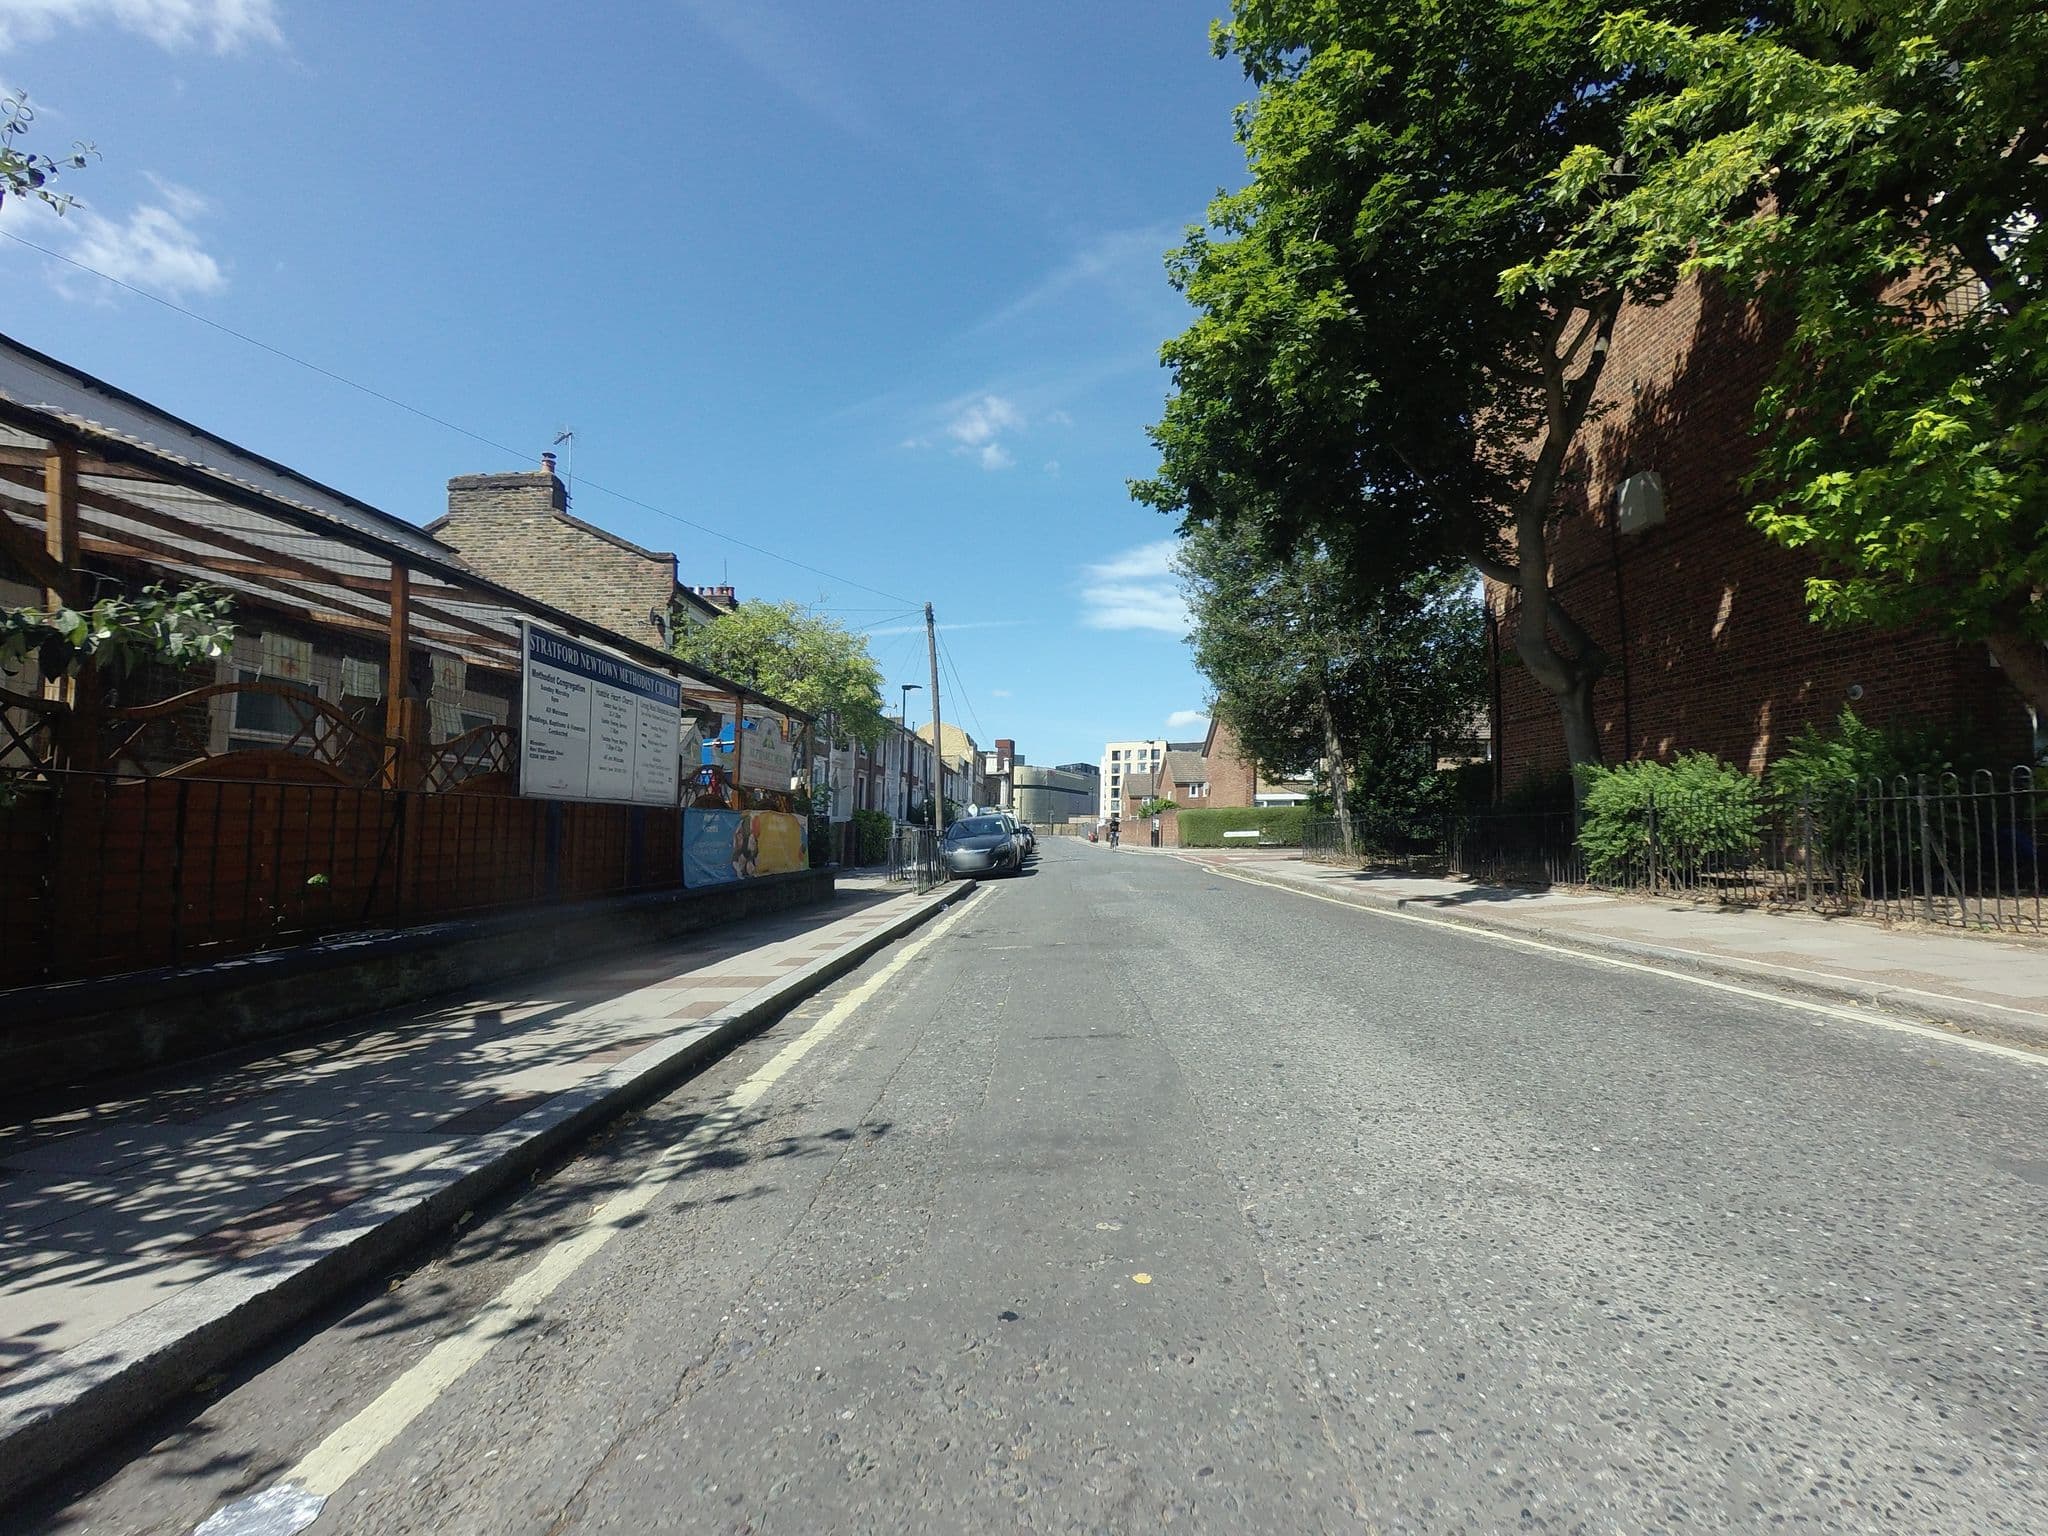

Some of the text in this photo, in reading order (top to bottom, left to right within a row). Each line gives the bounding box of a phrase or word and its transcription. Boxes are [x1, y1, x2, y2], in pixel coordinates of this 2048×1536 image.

[529, 635, 678, 701] STRATFORD NEWTOWN METHODIST CHURCH
[556, 676, 586, 694] Congregation
